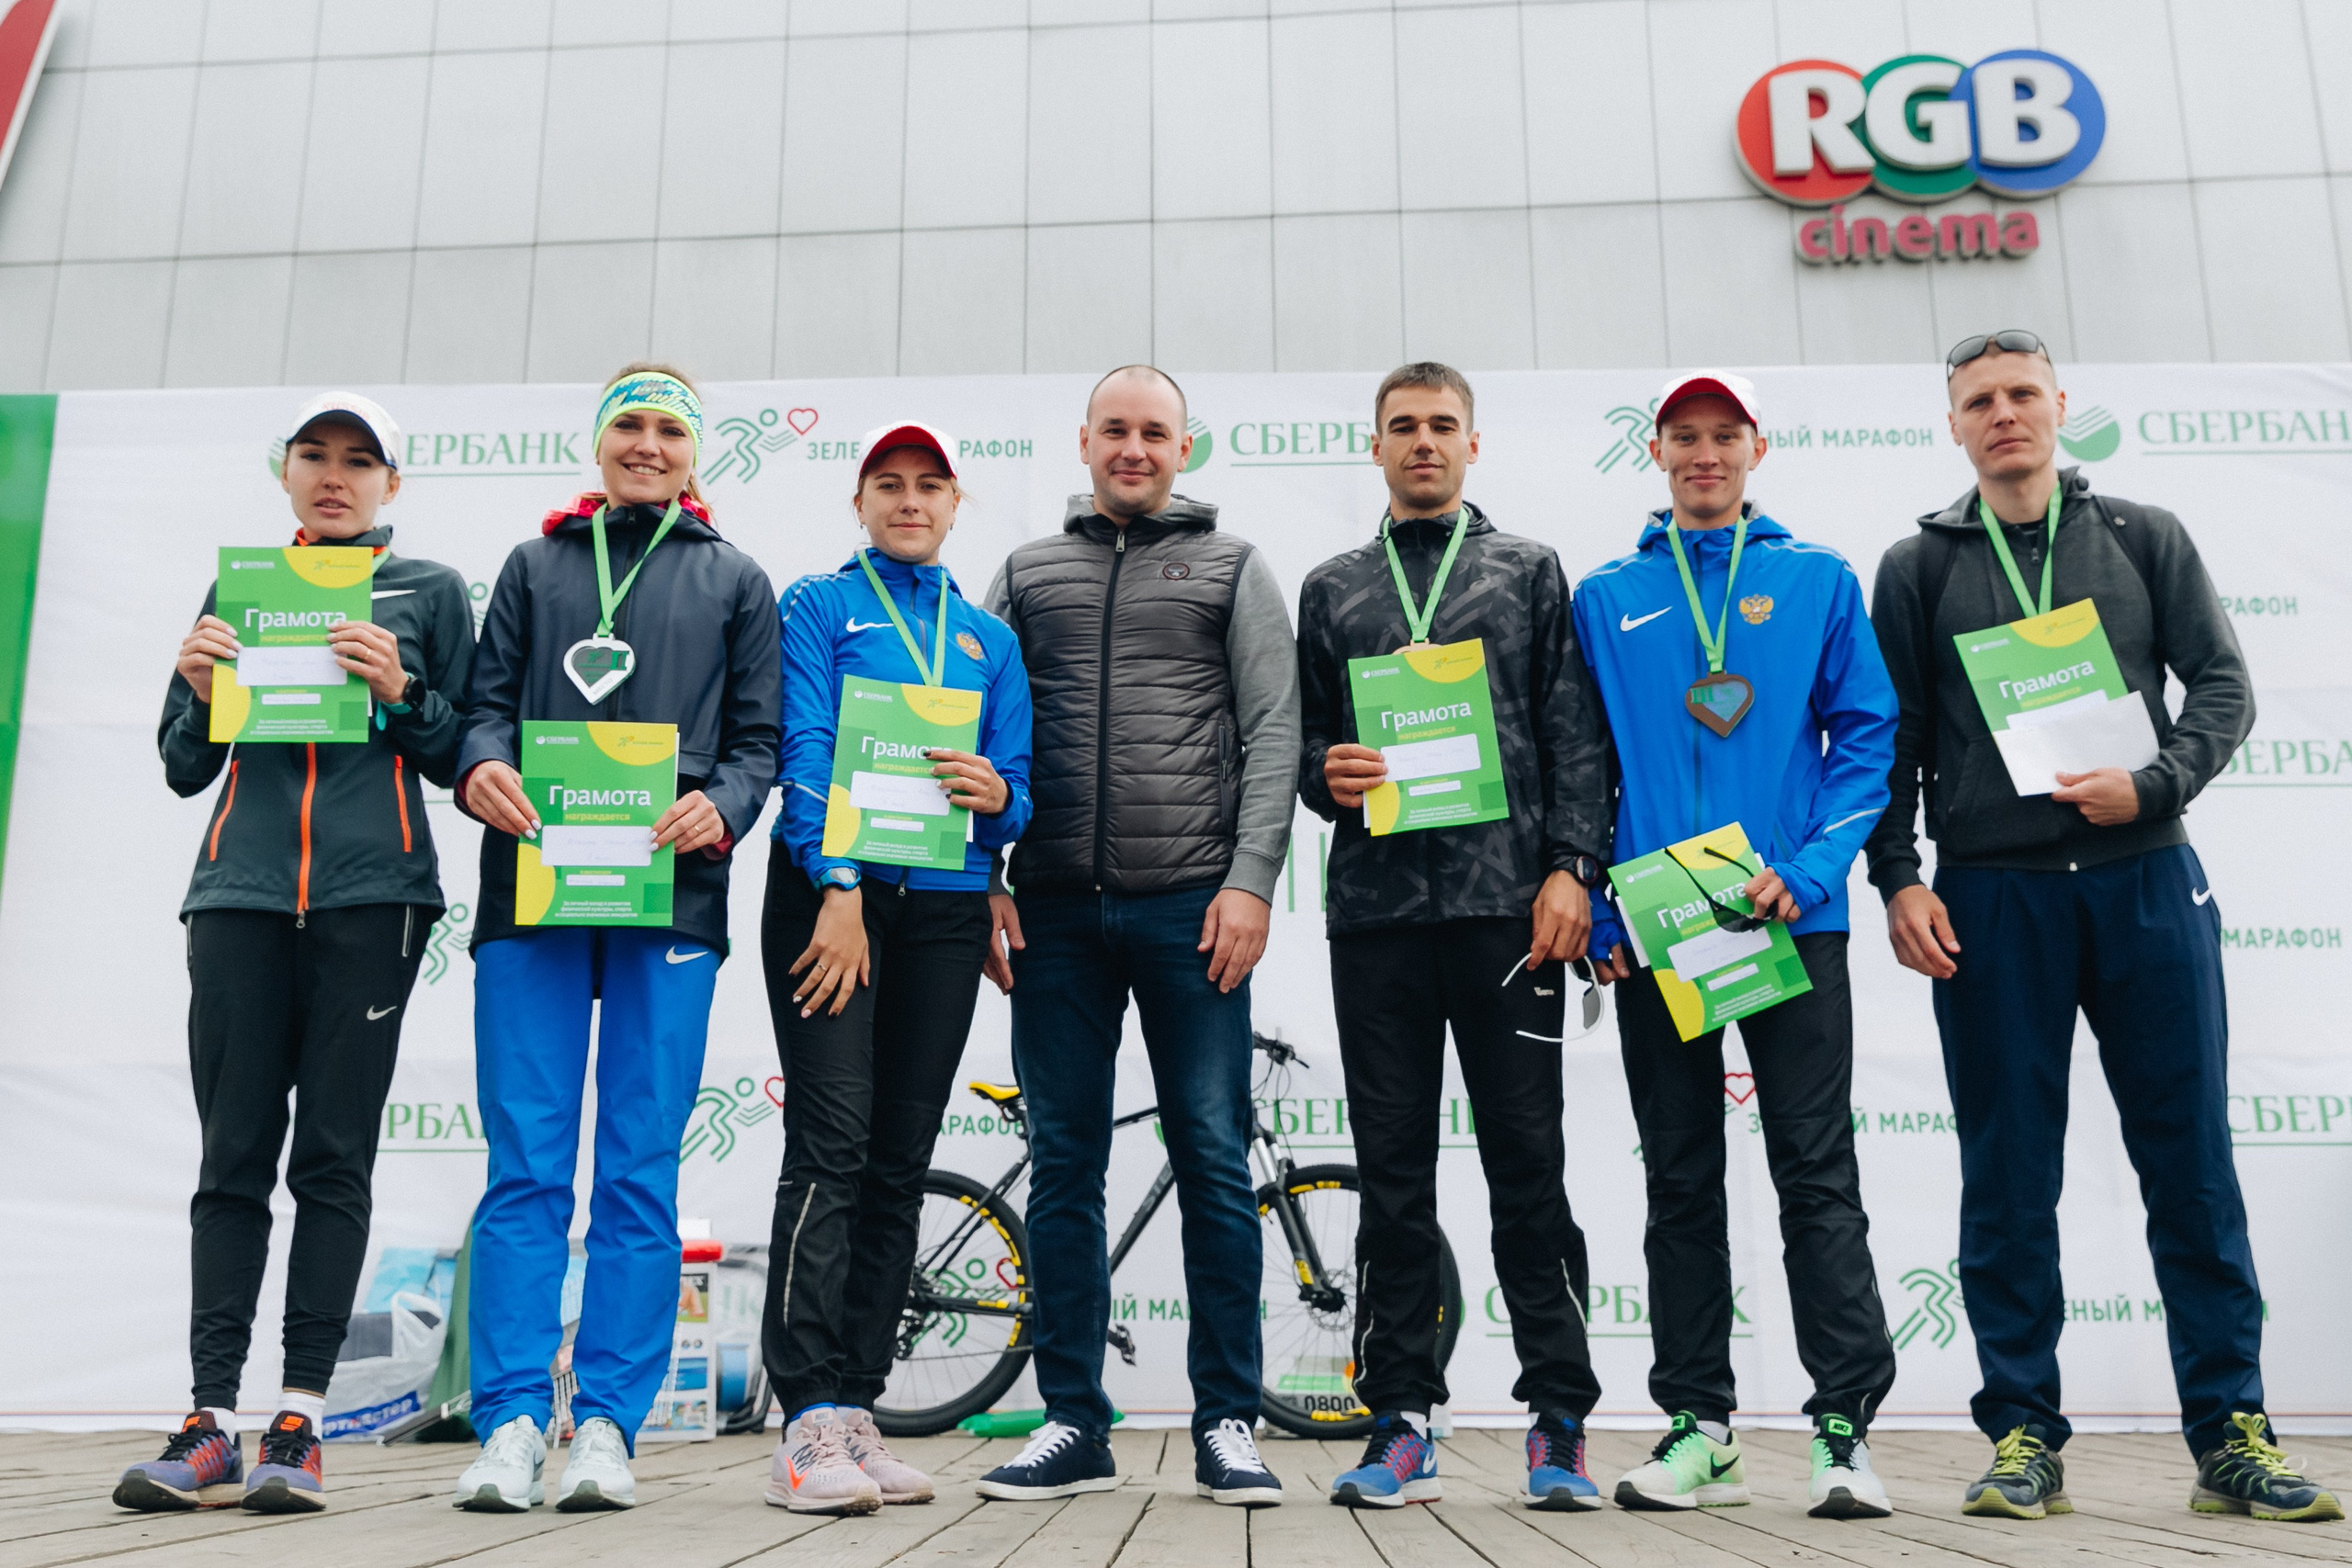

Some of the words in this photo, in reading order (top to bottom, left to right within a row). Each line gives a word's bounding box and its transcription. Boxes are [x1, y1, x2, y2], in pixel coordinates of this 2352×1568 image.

[1769, 58, 2081, 176] RGB
[1797, 204, 2040, 264] cinema
[1229, 422, 1372, 456] СБЕРБ
[1823, 428, 1934, 448] МАРАФОН
[2138, 410, 2351, 445] СБЕРБАН
[406, 432, 582, 467] ЕРБАНК
[807, 441, 860, 460] ЗЕЛЕ
[959, 439, 1033, 458] РАФОН
[2219, 597, 2298, 615] РАФОН
[245, 608, 346, 633] Грамота
[1998, 660, 2096, 700] Грамота
[1381, 702, 1472, 732] Грамота
[874, 762, 933, 774] награждаетс
[549, 785, 651, 810] Грамота
[565, 813, 630, 821] награждается
[2222, 928, 2342, 948] МАРАФОН
